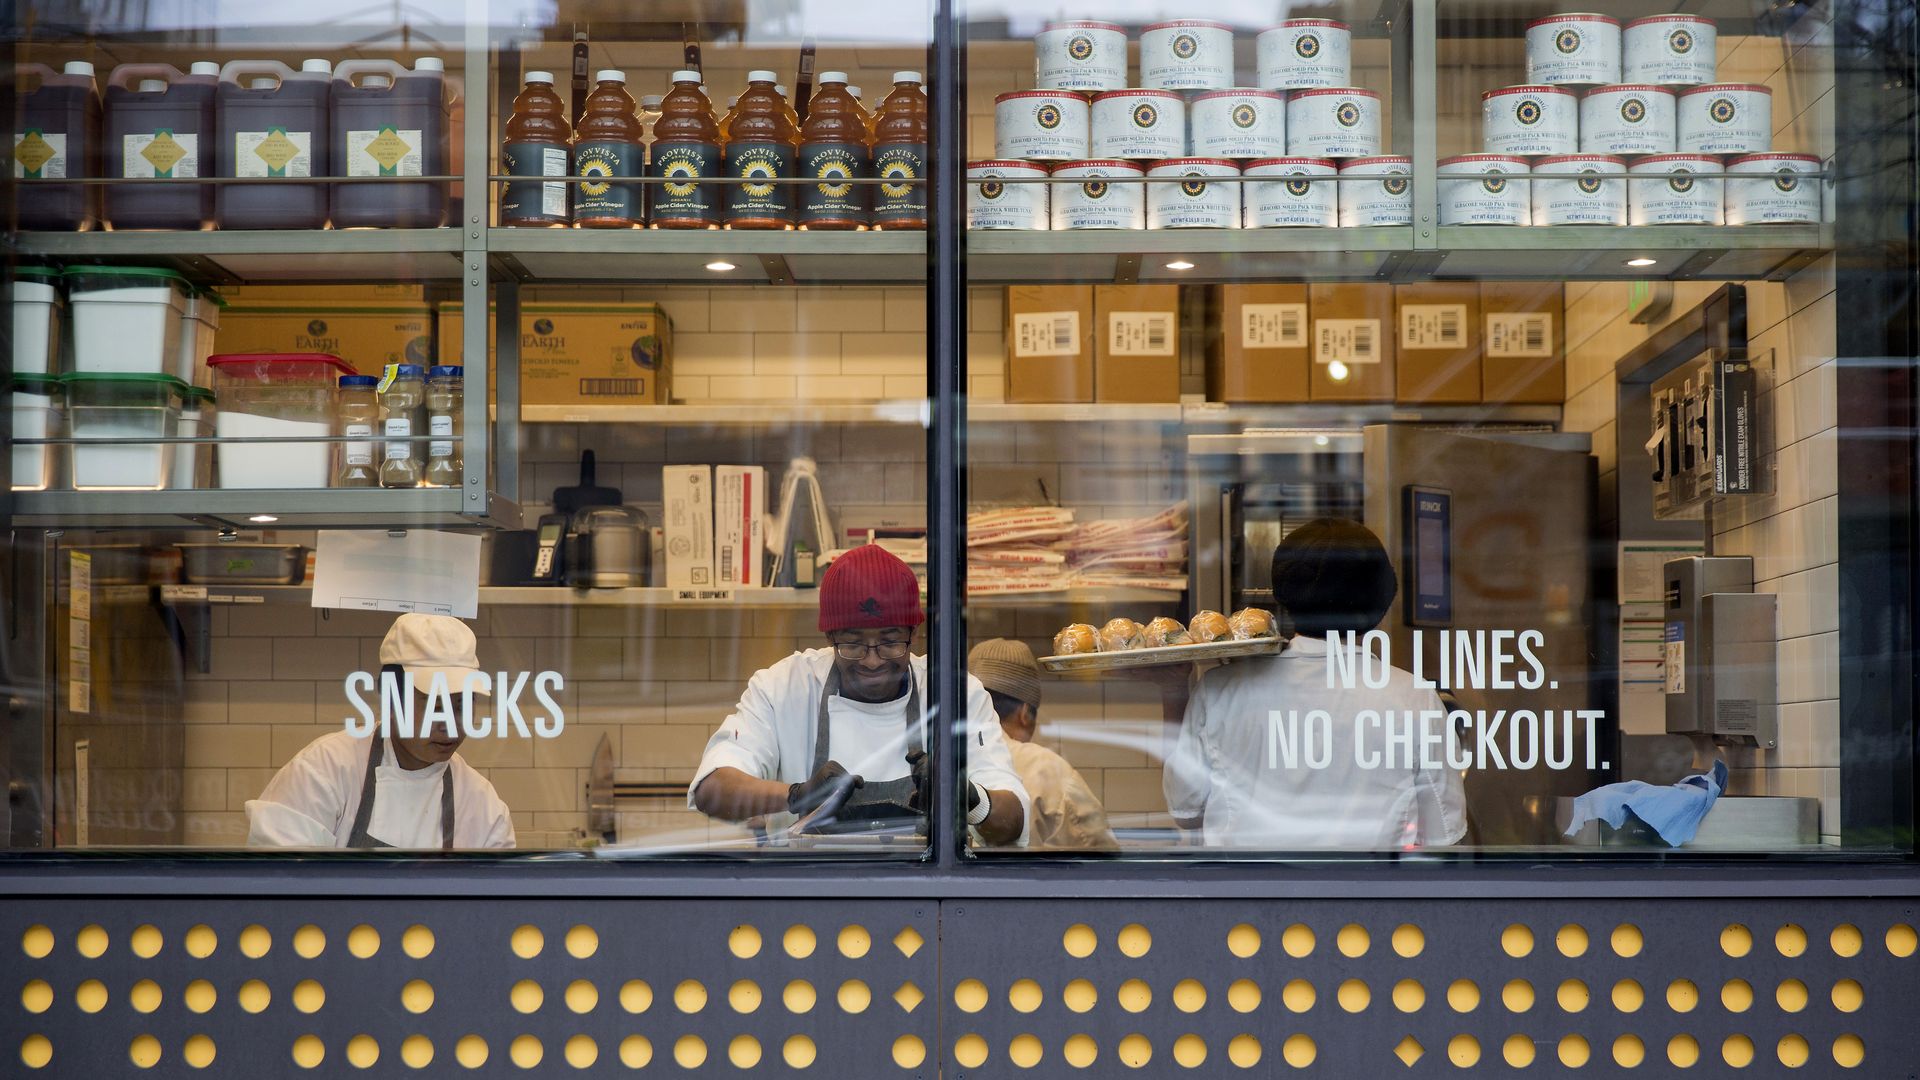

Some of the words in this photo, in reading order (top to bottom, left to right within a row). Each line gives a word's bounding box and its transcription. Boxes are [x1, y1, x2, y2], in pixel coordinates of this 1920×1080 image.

[576, 148, 620, 166] PROVVISTA
[658, 148, 706, 166] PROVVISTA
[734, 148, 784, 167] PROVVISTA
[810, 149, 859, 168] PROVVISTA
[876, 149, 922, 168] PROVVISTA
[296, 336, 338, 349] EARTH
[522, 337, 565, 348] EARTH
[1326, 630, 1390, 689] NO
[1414, 630, 1558, 689] LINES.
[344, 670, 564, 740] SNACKS
[1268, 710, 1332, 770] NO
[1355, 710, 1610, 770] CHECKOUT.
